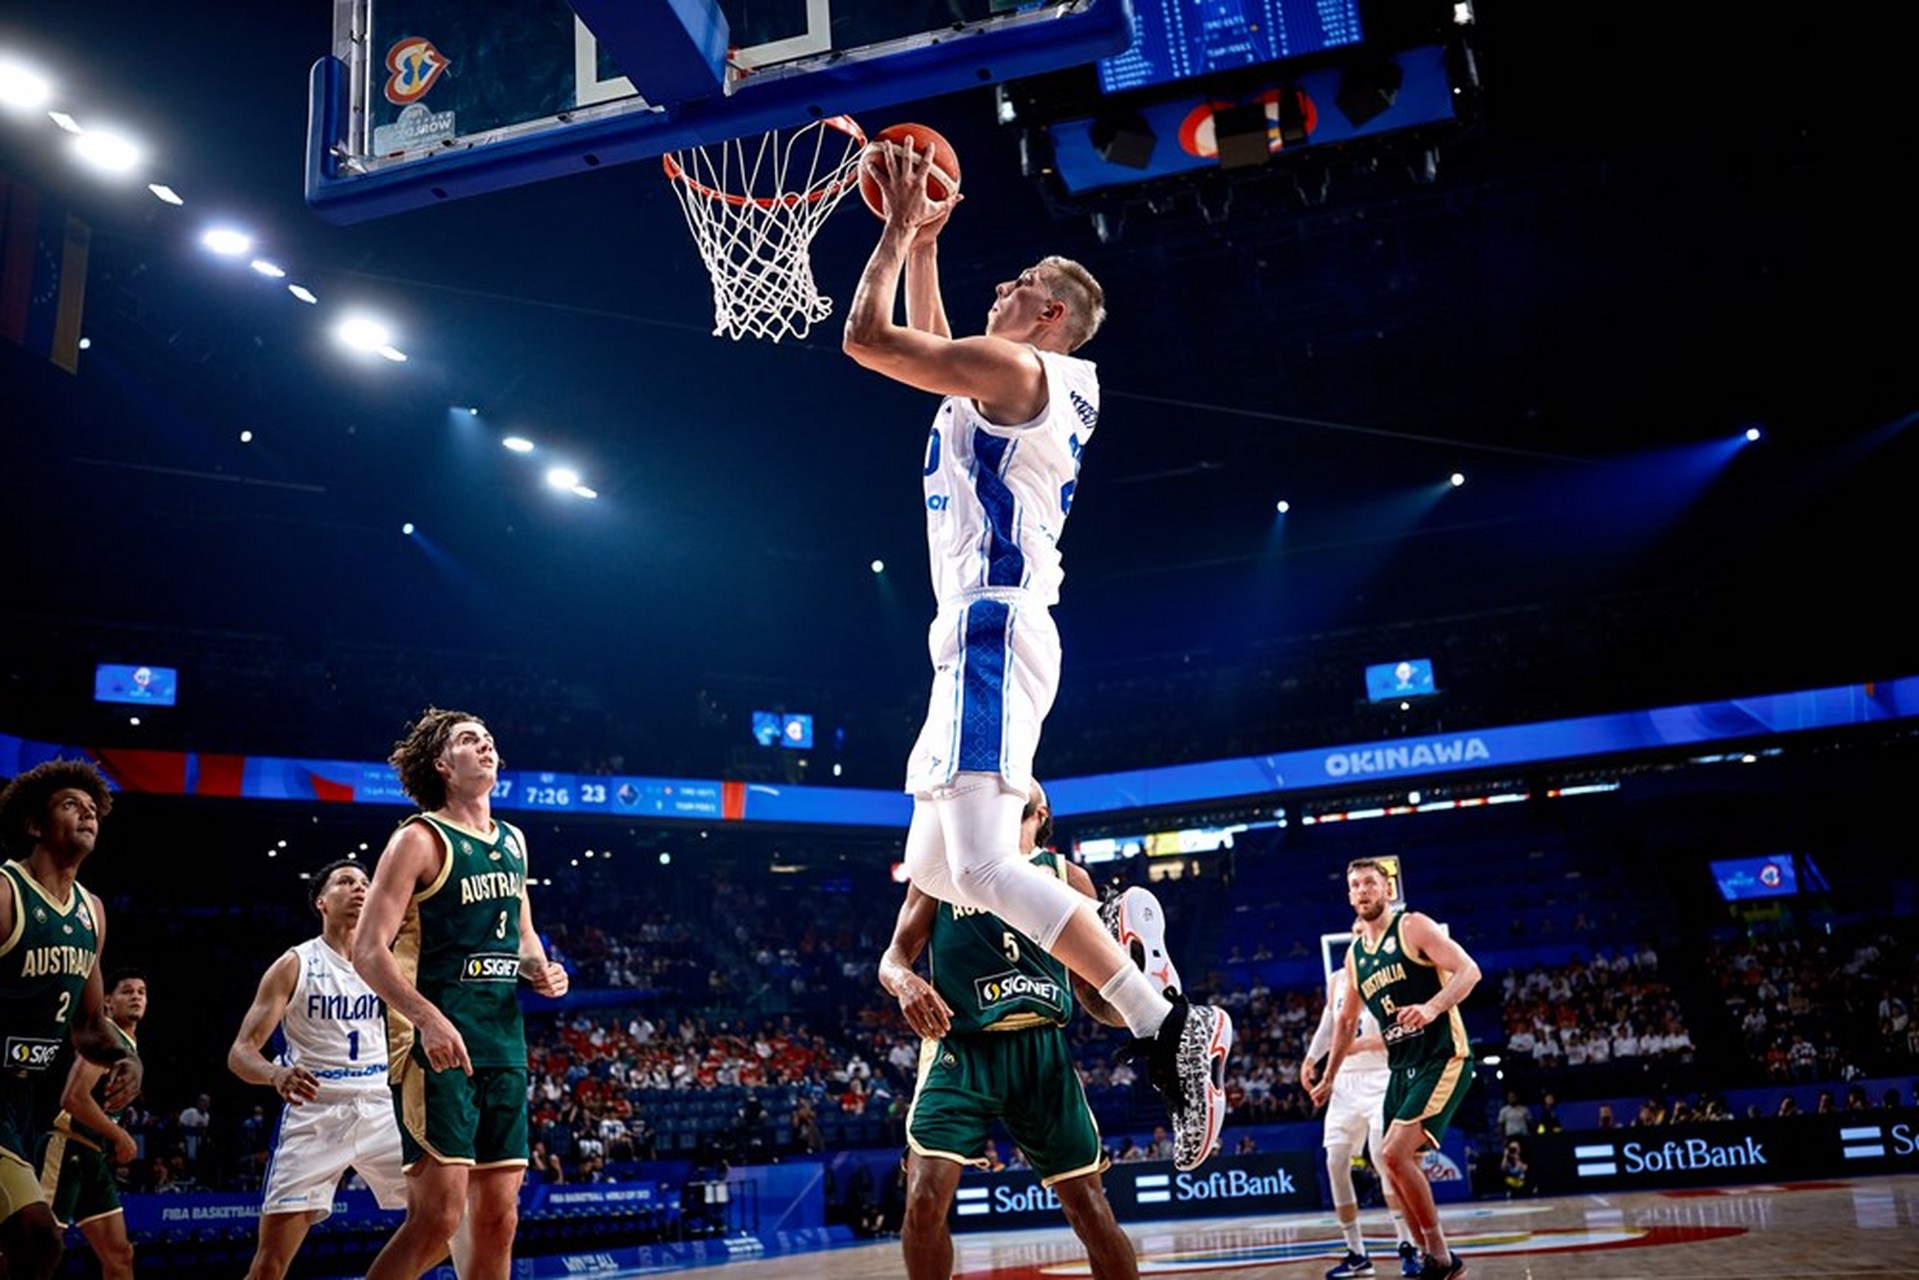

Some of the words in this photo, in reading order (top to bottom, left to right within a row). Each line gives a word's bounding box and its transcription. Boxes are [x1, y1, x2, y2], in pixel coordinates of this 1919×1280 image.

[1325, 738, 1490, 777] OKINAWA
[526, 787, 569, 806] 7:26
[581, 784, 606, 804] 23
[496, 910, 507, 939] 3
[1002, 931, 1020, 963] 5
[1001, 975, 1060, 1001] SIGNET
[55, 991, 71, 1022] 2
[346, 1030, 360, 1061] 1
[1623, 1137, 1768, 1174] SoftBank
[1891, 1124, 1919, 1156] S
[1175, 1168, 1297, 1201] SoftBank
[162, 1207, 189, 1221] FIBA
